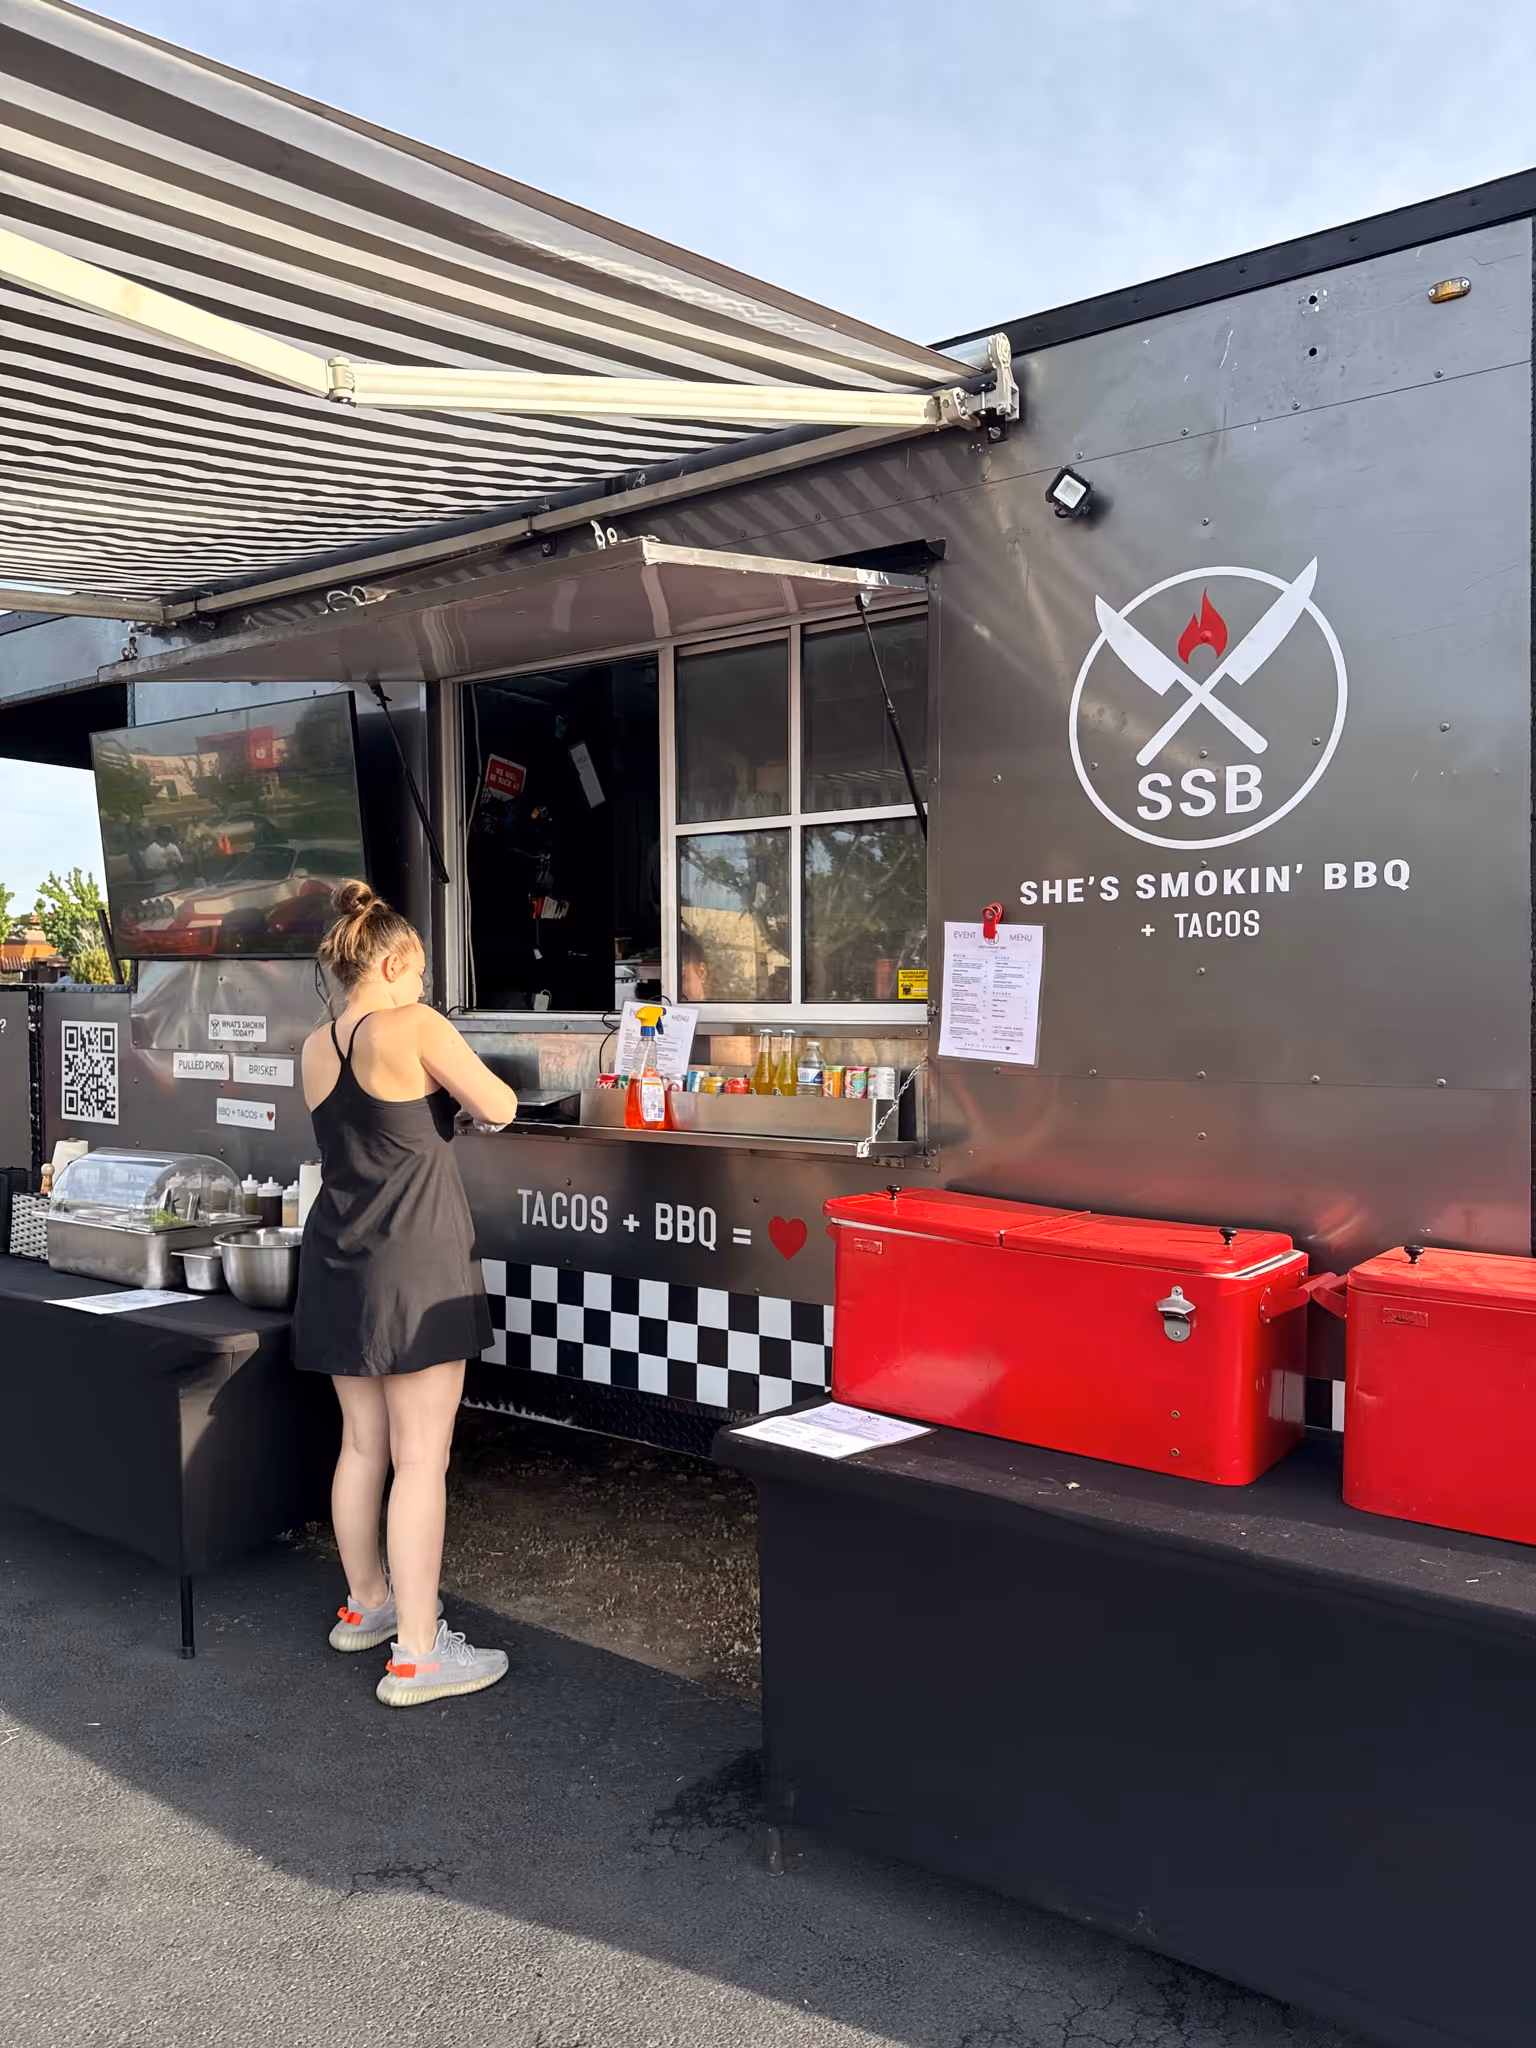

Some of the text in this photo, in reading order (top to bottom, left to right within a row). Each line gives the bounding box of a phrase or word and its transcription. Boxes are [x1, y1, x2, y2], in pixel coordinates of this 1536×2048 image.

[1137, 764, 1263, 821] SSB
[1020, 859, 1411, 905] SHE'S SMOKIN' BBQ
[1141, 910, 1261, 938] + TACOS
[953, 931, 1033, 942] EVENT MENU
[671, 1014, 690, 1023] MENU
[232, 1029, 254, 1037] TODAY?
[178, 1059, 225, 1072] PULLED PORK
[248, 1064, 278, 1077] BRISKET
[218, 1106, 231, 1118] BBQ
[236, 1108, 258, 1120] TACOS
[517, 1188, 608, 1234] TACOS
[622, 1213, 640, 1233] +
[655, 1202, 717, 1251] BBQ
